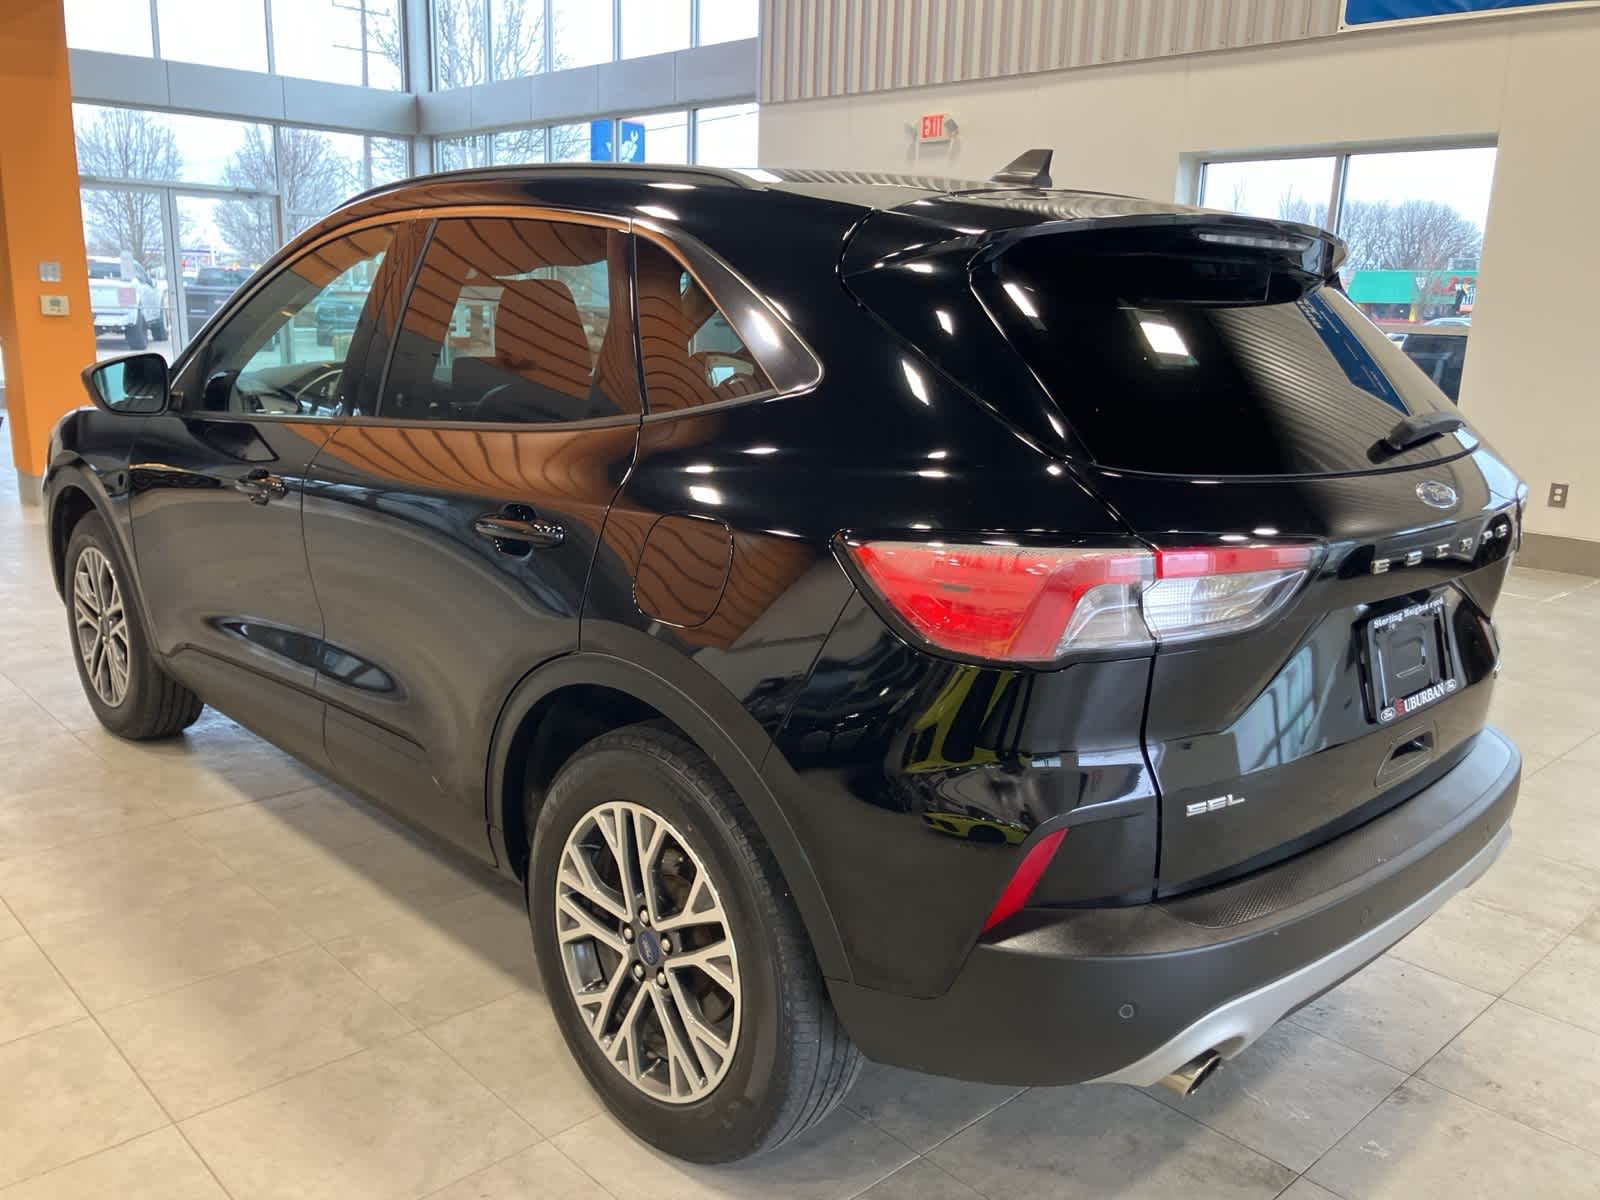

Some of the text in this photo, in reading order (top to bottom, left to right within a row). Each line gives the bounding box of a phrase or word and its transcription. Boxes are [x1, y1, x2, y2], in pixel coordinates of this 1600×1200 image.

[922, 115, 944, 138] EXIT
[1371, 524, 1507, 575] ESCAPE
[1374, 612, 1403, 629] Sterling
[1395, 682, 1445, 716] SUBURBAN
[1186, 794, 1245, 817] SEL
